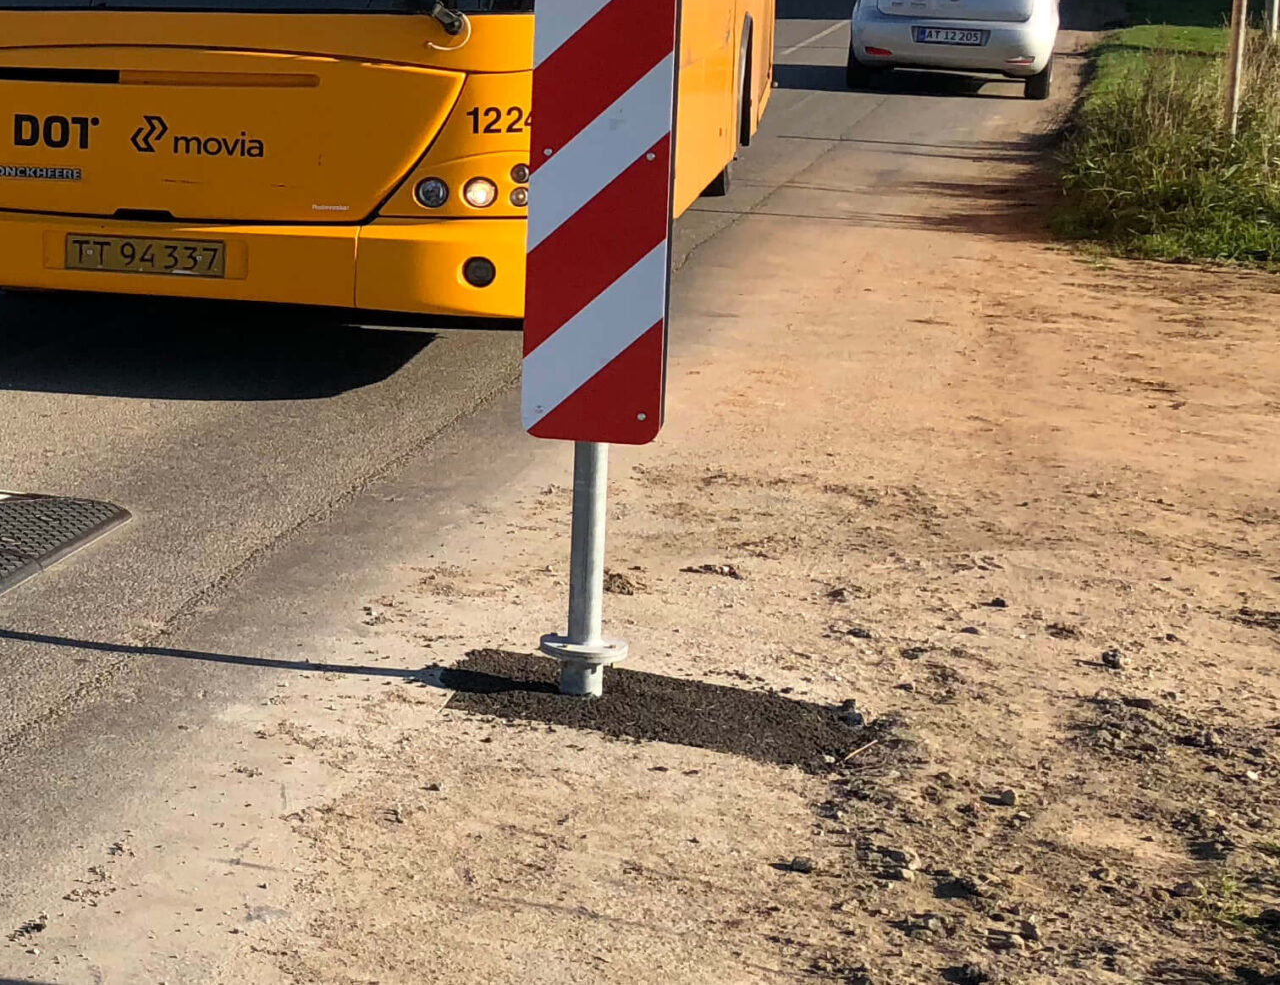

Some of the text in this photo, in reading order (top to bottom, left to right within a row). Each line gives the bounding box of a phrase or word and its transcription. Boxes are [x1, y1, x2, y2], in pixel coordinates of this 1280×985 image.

[926, 30, 979, 42] AT 12 205
[14, 114, 100, 149] DOT
[173, 131, 264, 157] movia
[72, 240, 218, 271] TT 94 337
